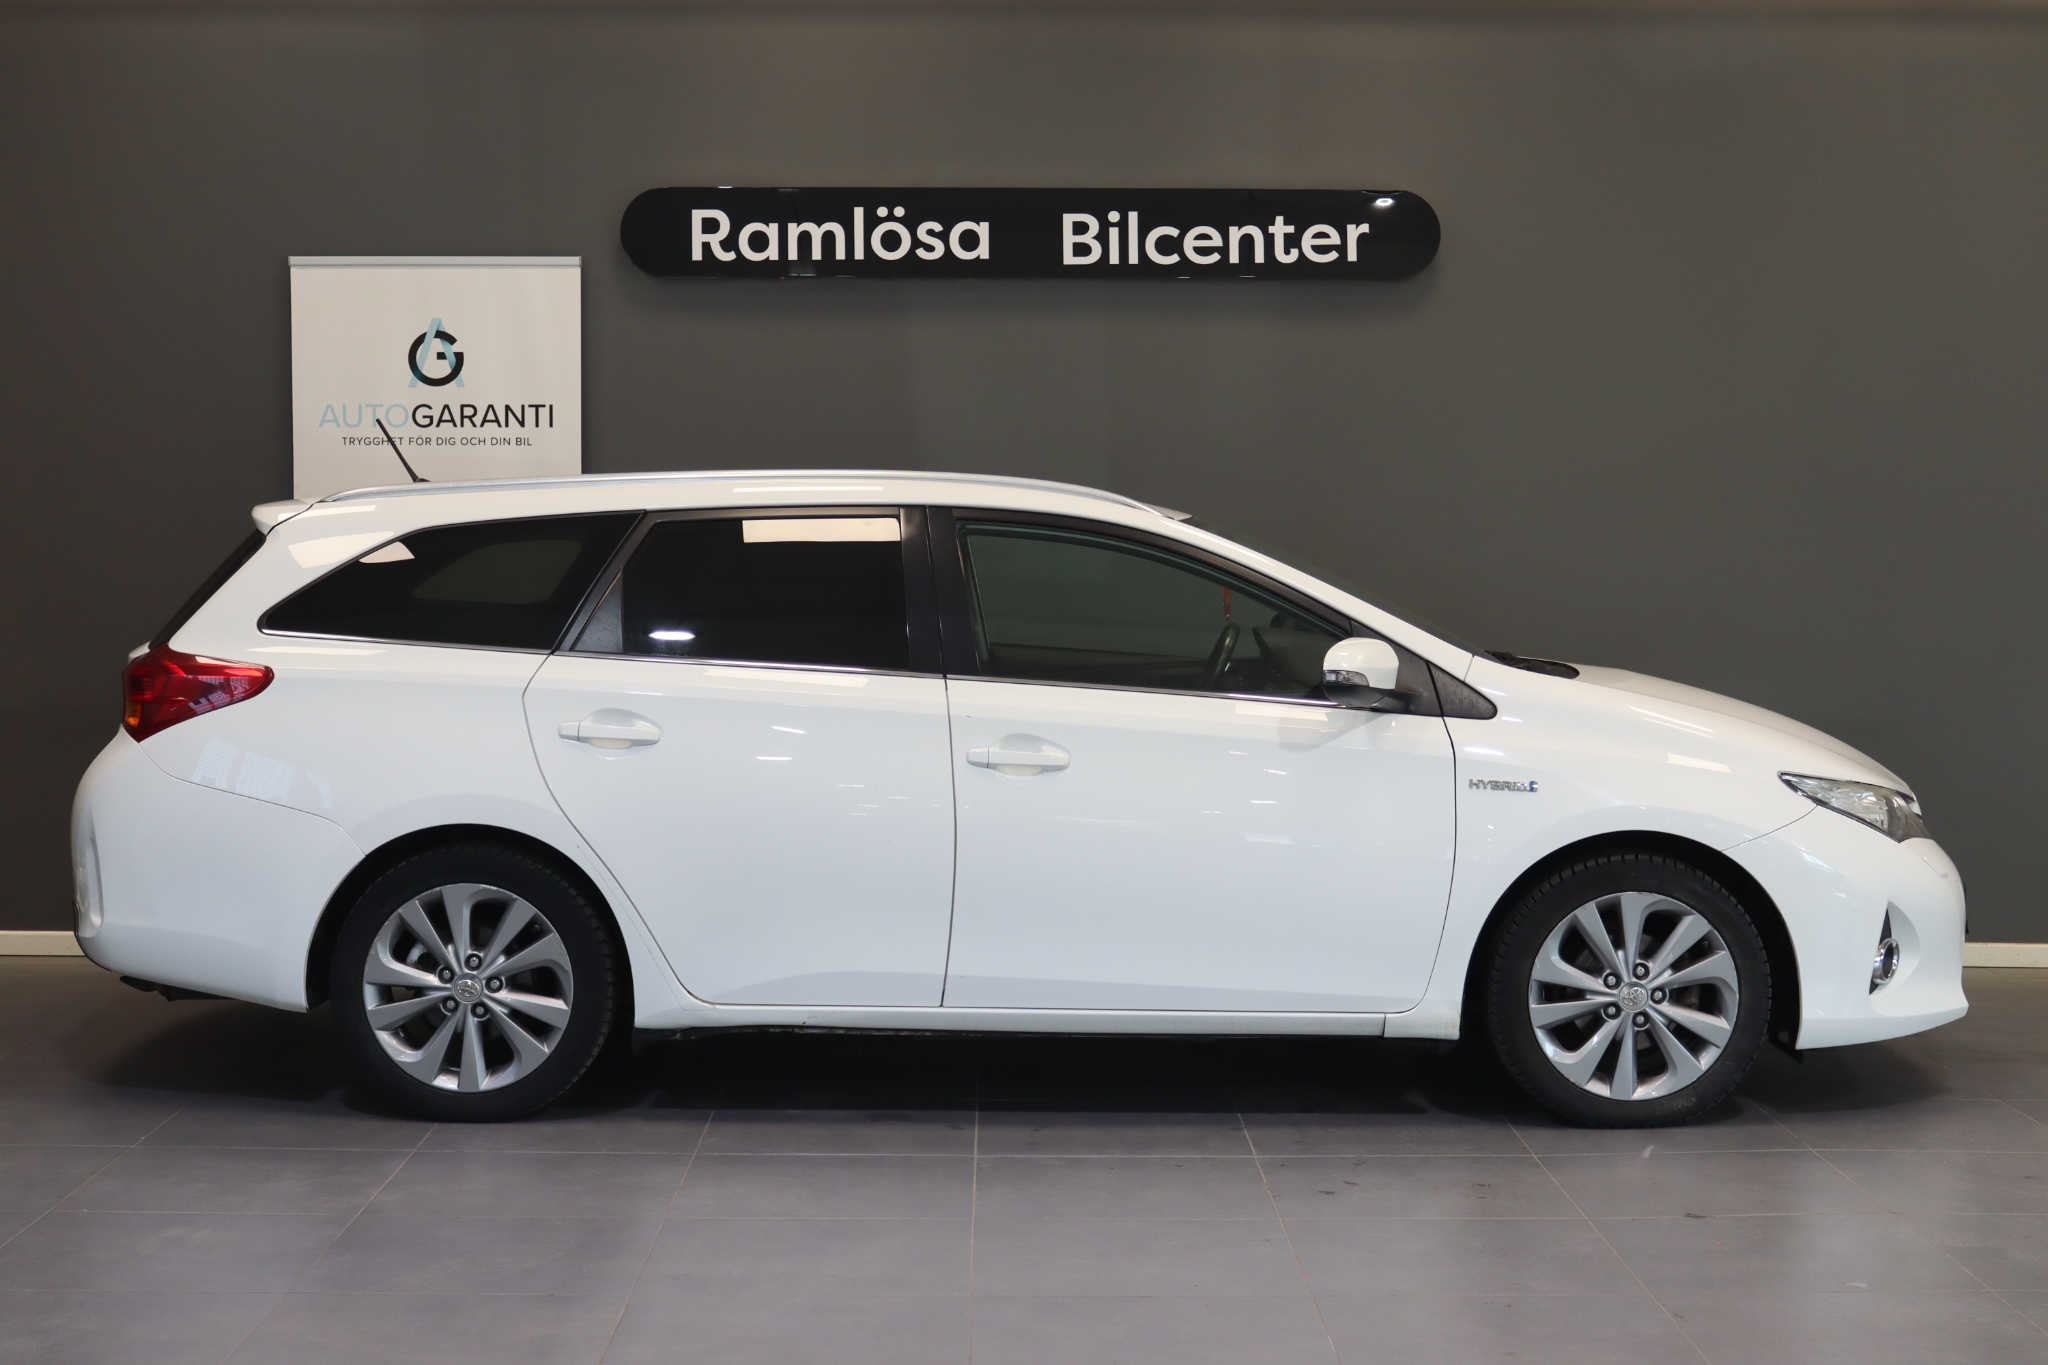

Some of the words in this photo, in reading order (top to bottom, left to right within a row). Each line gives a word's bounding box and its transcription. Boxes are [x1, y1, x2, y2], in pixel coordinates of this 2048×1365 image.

[691, 206, 990, 262] Ramlösa
[1062, 205, 1370, 265] Bilcenter
[318, 403, 554, 429] AUTOGARANTI
[408, 434, 432, 446] FÖR
[436, 436, 456, 446] DIG
[460, 436, 486, 446] OCH
[490, 436, 511, 446] DIN
[515, 436, 533, 446] BIL
[1469, 779, 1528, 792] HYBRID
